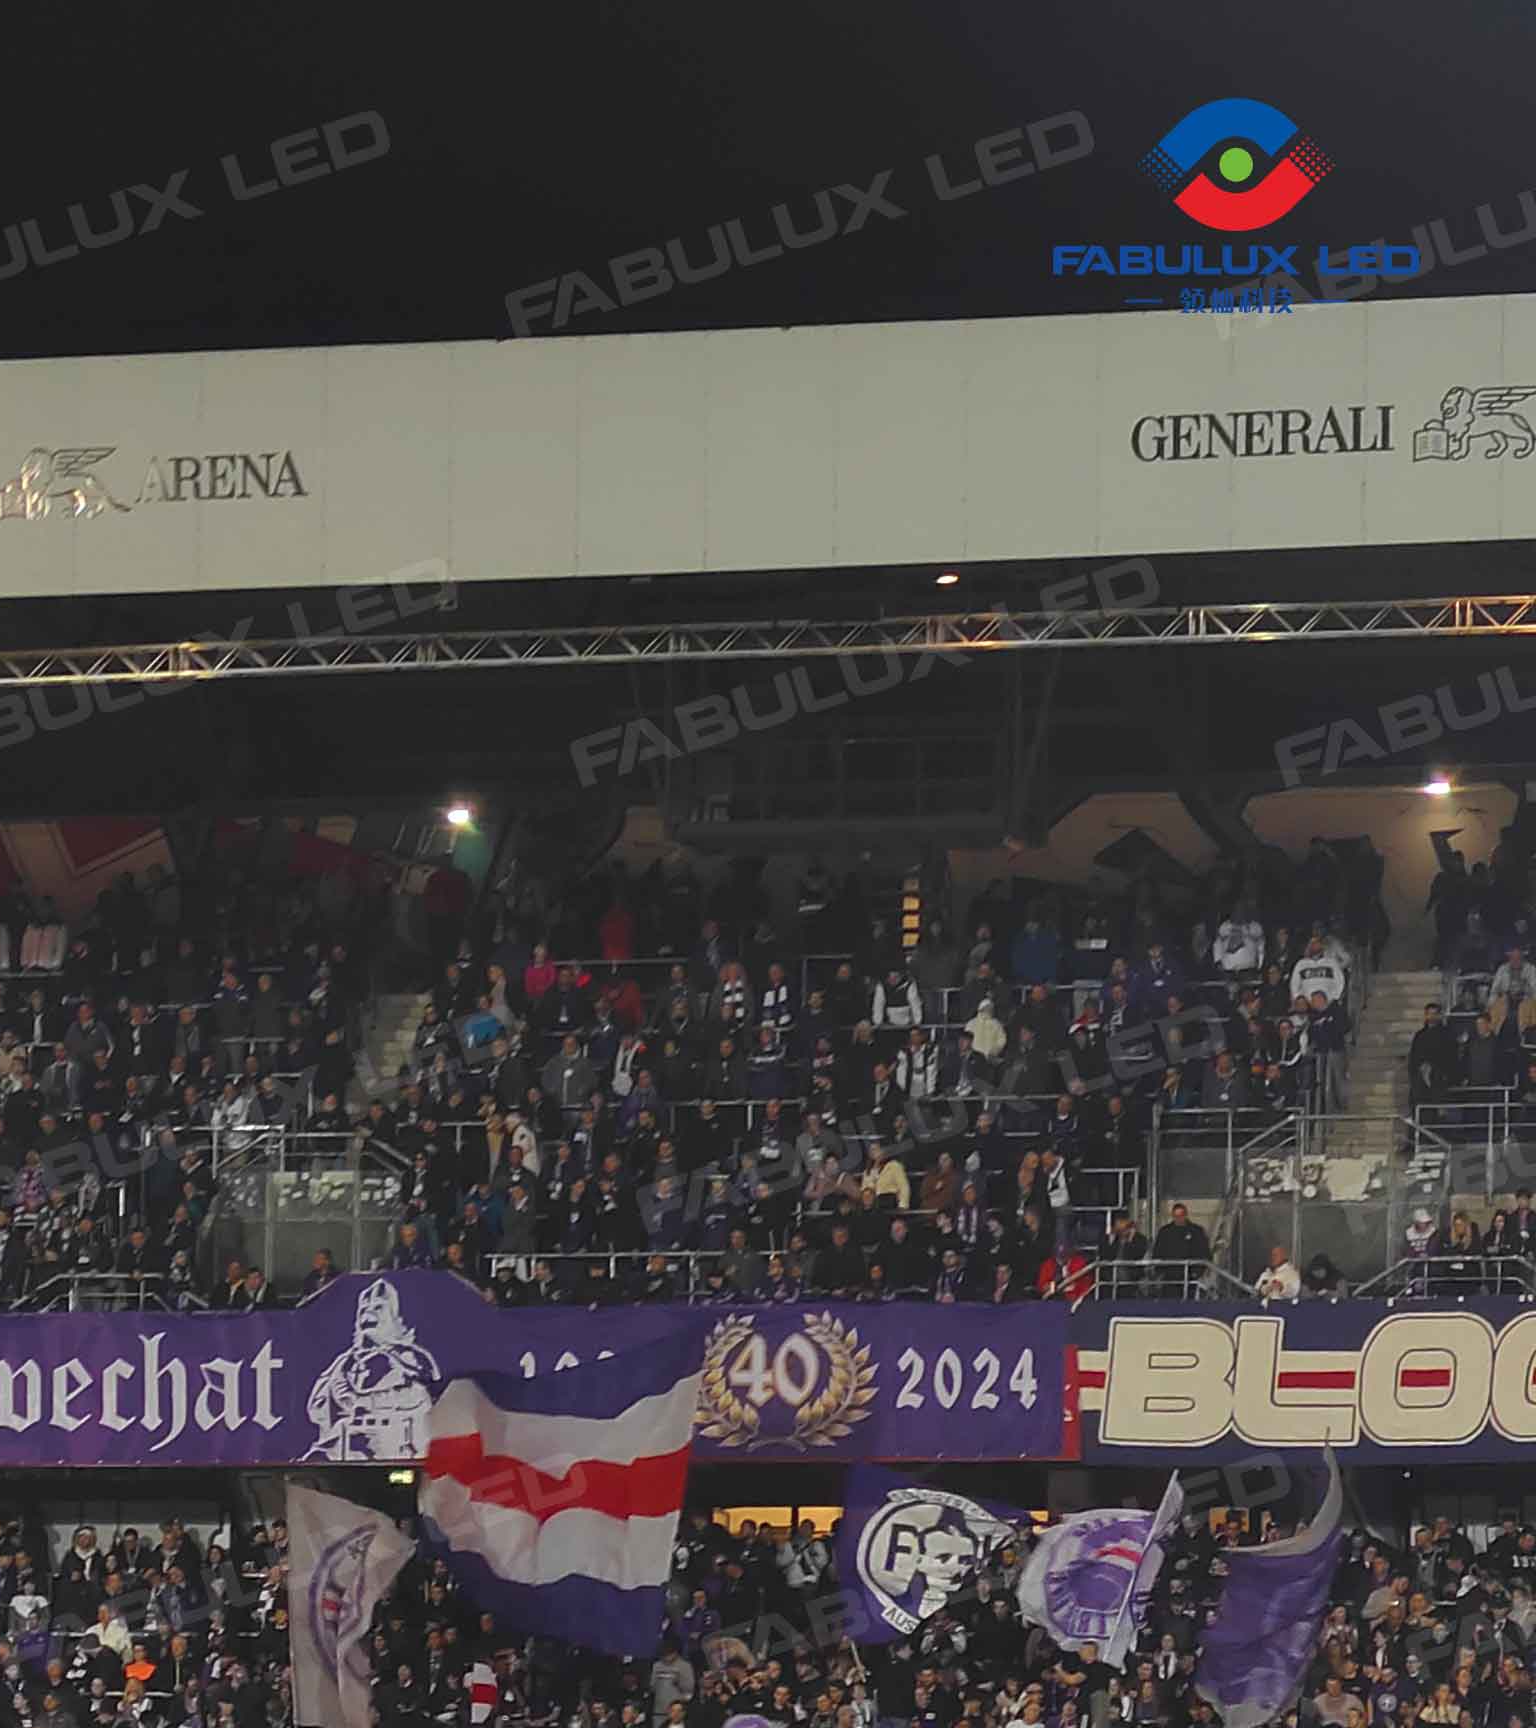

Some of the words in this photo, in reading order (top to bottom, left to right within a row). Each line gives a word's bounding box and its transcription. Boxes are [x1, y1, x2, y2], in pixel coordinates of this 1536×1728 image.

[1131, 405, 1395, 463] GENERALI
[131, 449, 309, 505] ARENA
[728, 1332, 819, 1406] 40
[895, 1346, 1038, 1411] 2024
